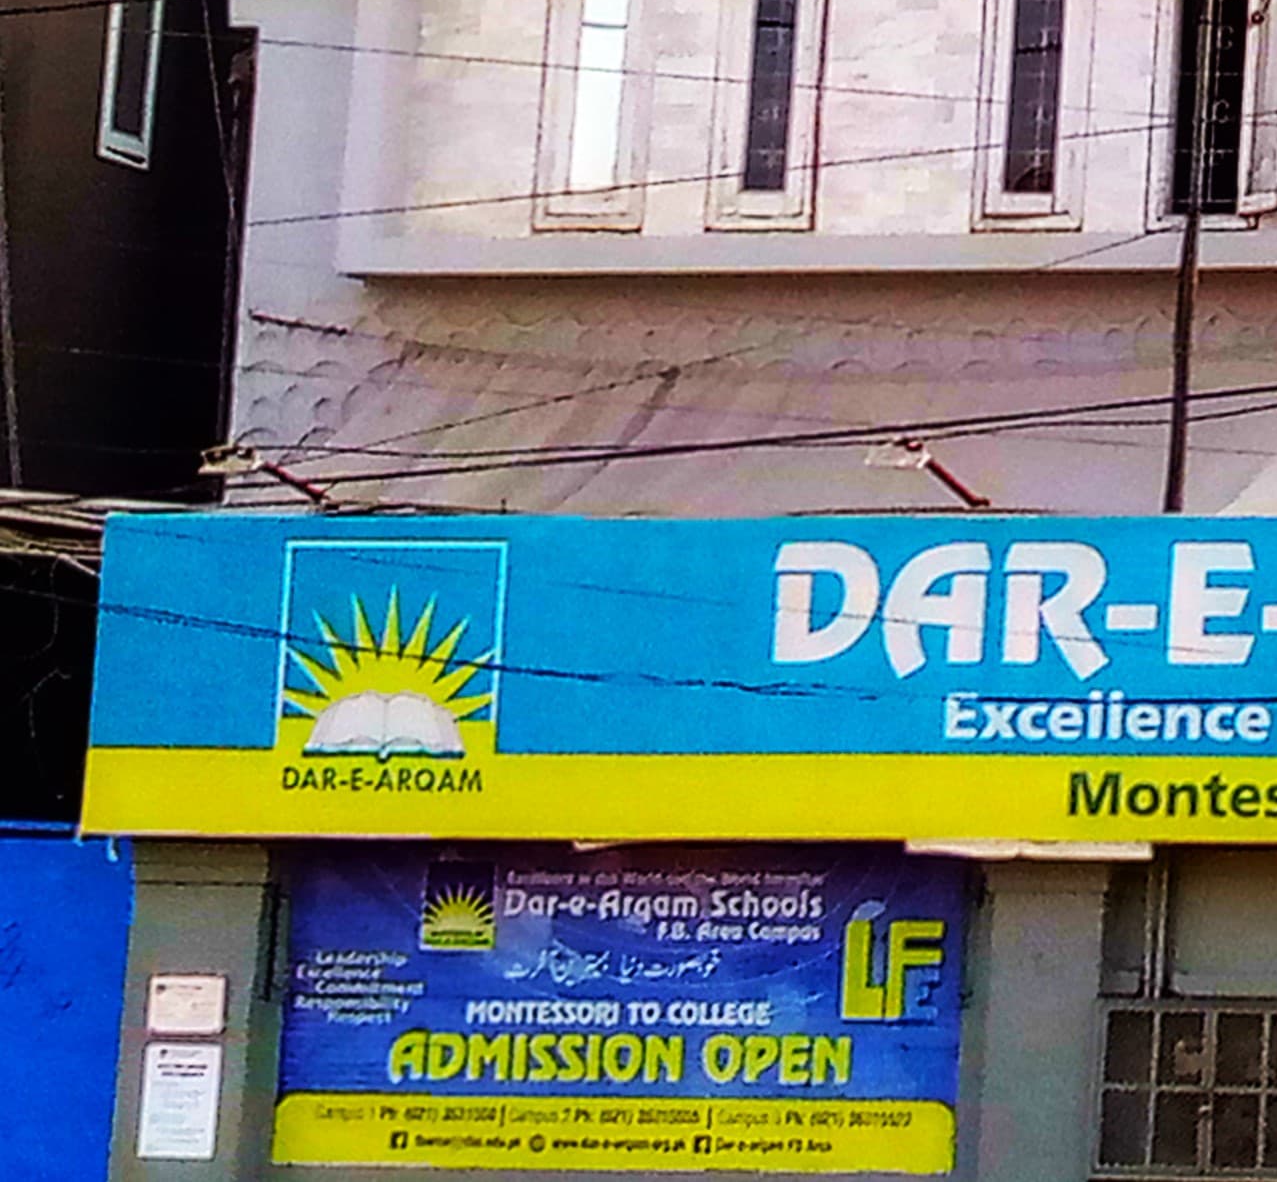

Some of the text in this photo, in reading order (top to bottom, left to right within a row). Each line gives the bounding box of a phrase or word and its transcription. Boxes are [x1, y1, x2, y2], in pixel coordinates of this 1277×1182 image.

[943, 693, 1271, 742] Excellence
[281, 765, 484, 793] DAR-E-ARQAM
[503, 888, 823, 923] Dar-e-Arqam Schools
[696, 921, 743, 942] Area
[466, 999, 772, 1027] MONTESSORI TO COLLEGE
[388, 1029, 853, 1085] ADMISSION OPEN
